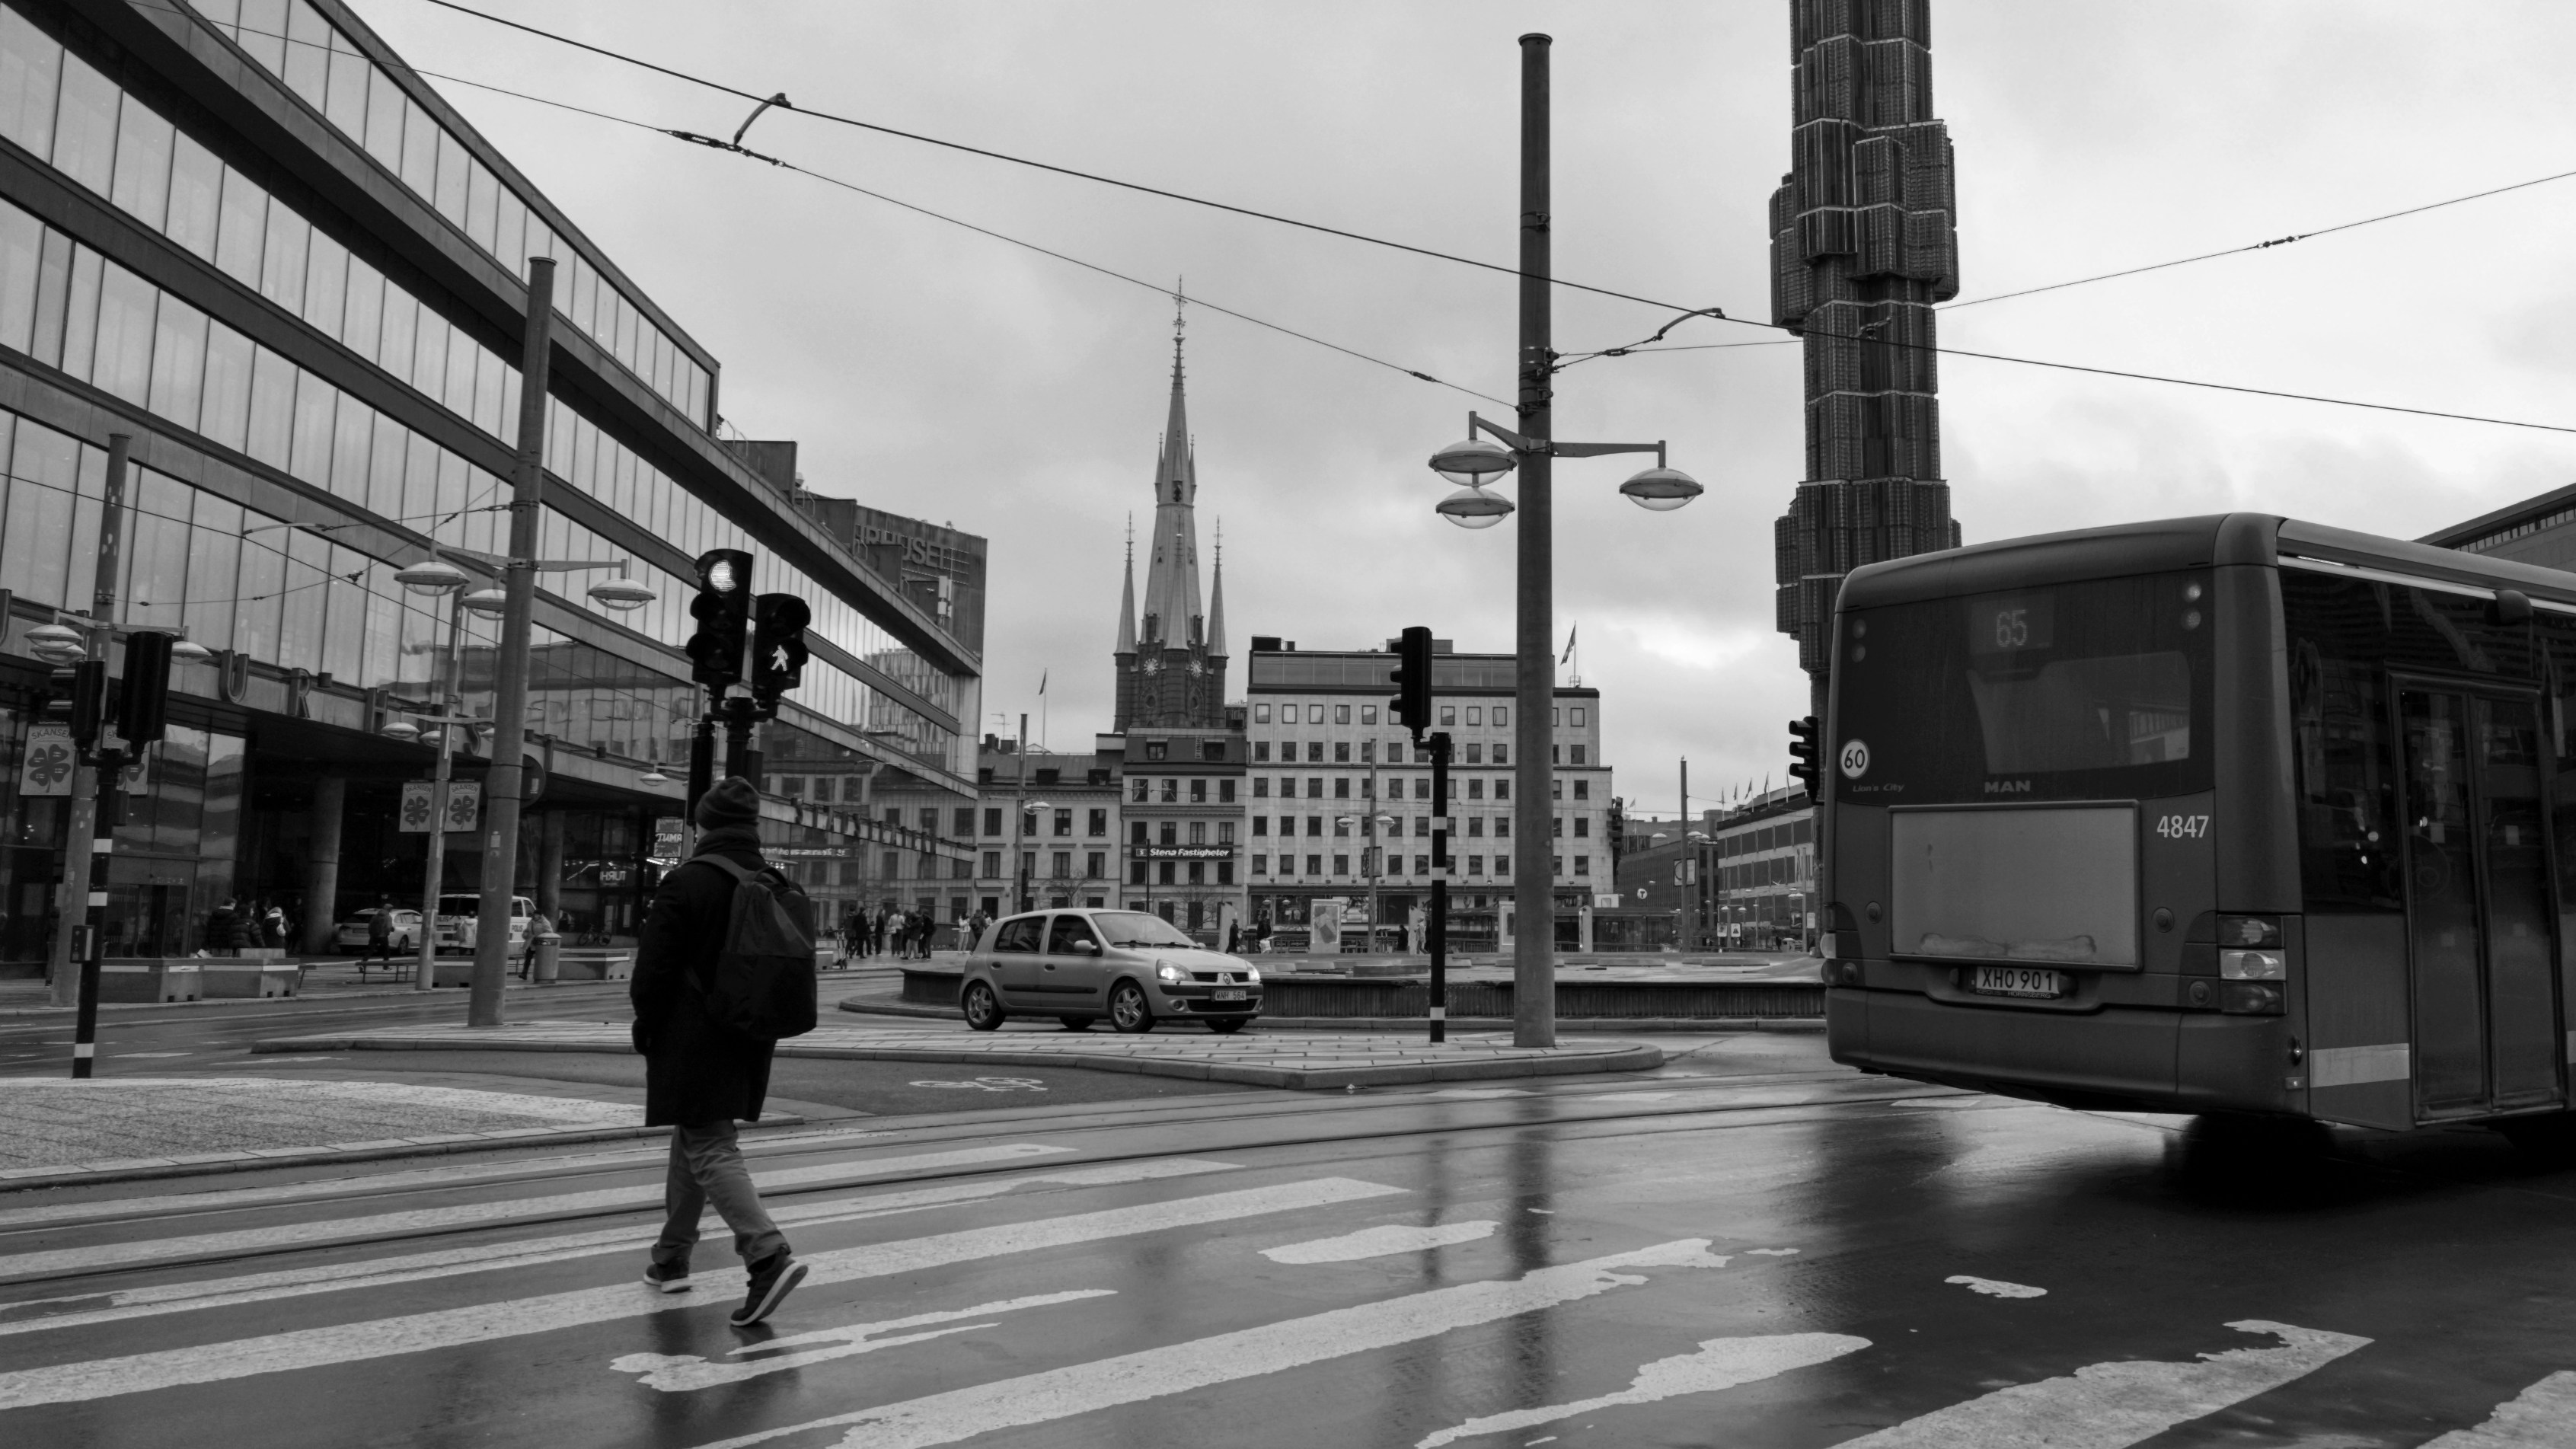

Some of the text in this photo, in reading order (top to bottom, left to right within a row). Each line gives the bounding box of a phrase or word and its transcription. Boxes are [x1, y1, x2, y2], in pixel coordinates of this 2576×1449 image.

[1997, 609, 2028, 647] 65
[31, 729, 71, 740] SKANSE
[1844, 748, 1866, 769] 60
[1882, 783, 1904, 792] City
[1984, 780, 2032, 793] MAN
[2156, 815, 2210, 838] 4847
[1150, 847, 1177, 857] Stena
[1178, 847, 1230, 858] Fastigheter
[1982, 968, 2053, 991] XHO 901
